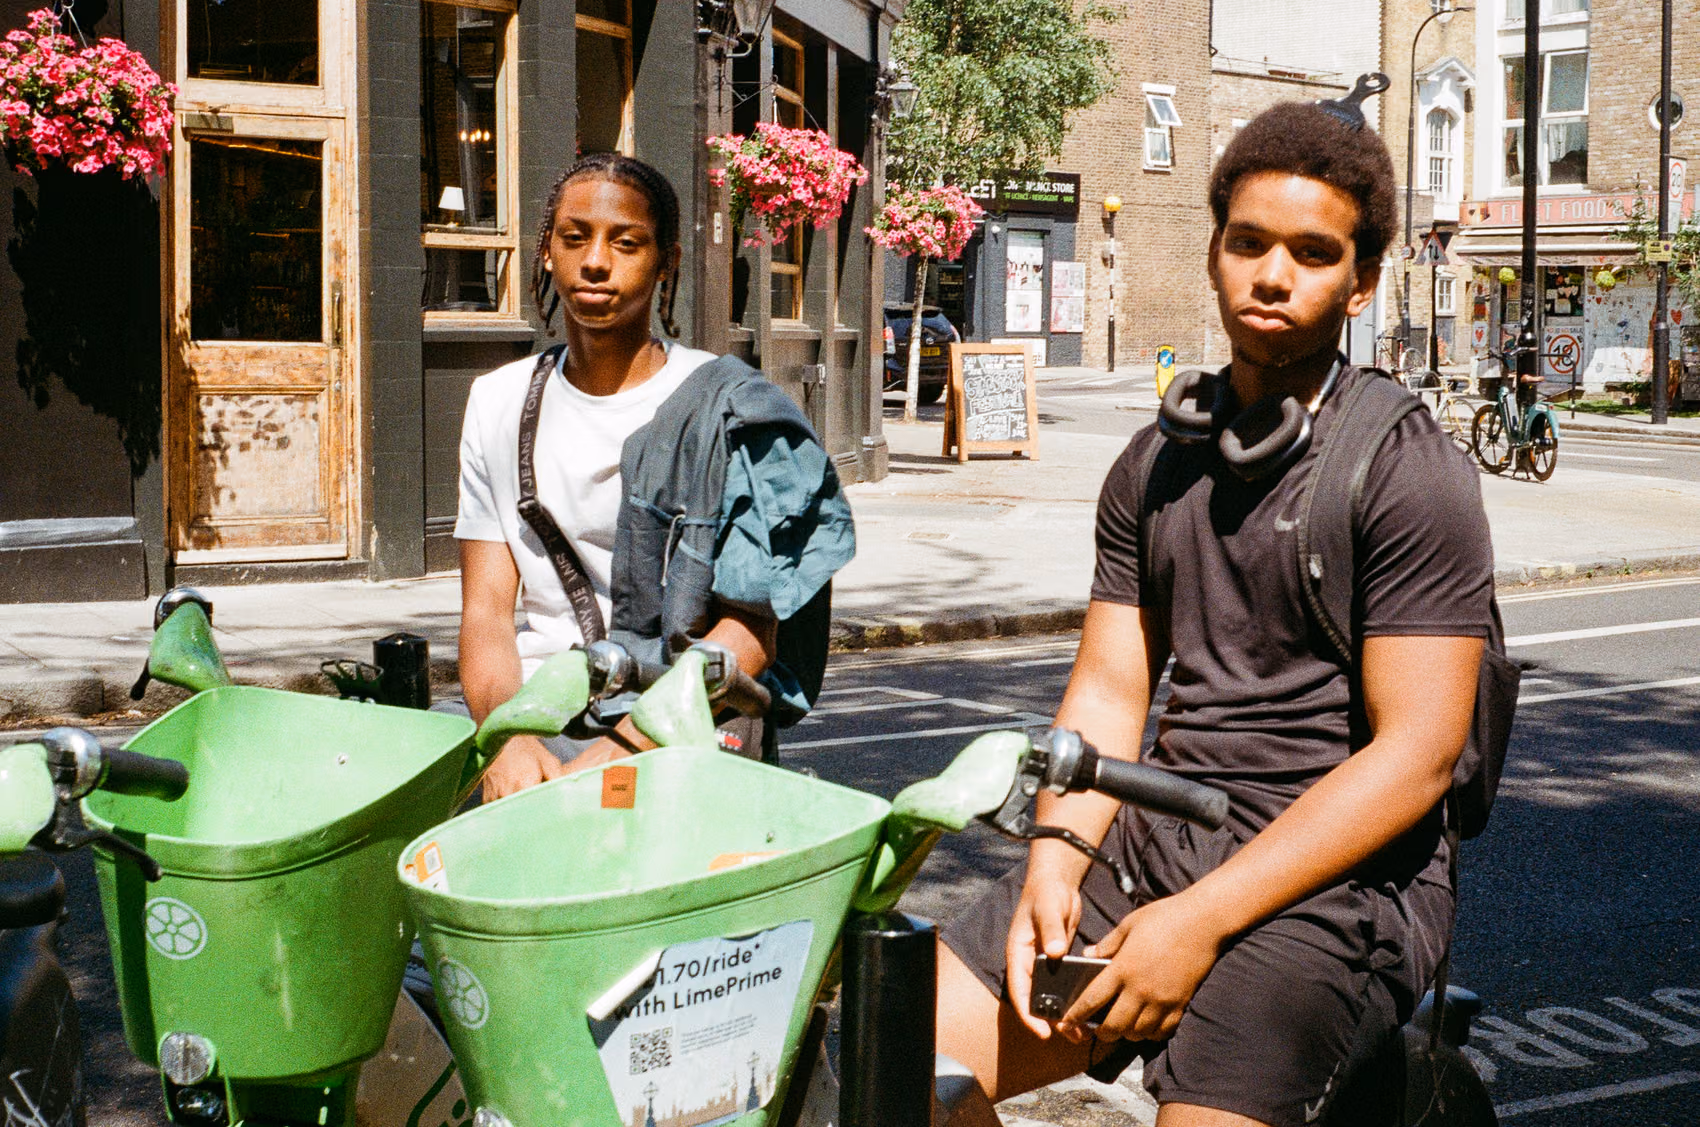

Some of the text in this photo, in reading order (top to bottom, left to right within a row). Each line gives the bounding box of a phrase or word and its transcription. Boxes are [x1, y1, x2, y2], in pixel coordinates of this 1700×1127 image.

[1052, 183, 1075, 193] STORE
[1501, 202, 1552, 222] FLT
[1561, 199, 1607, 219] FOOD
[1553, 344, 1573, 367] 18
[520, 431, 532, 487] JEANS
[673, 966, 783, 1010] LimePrime
